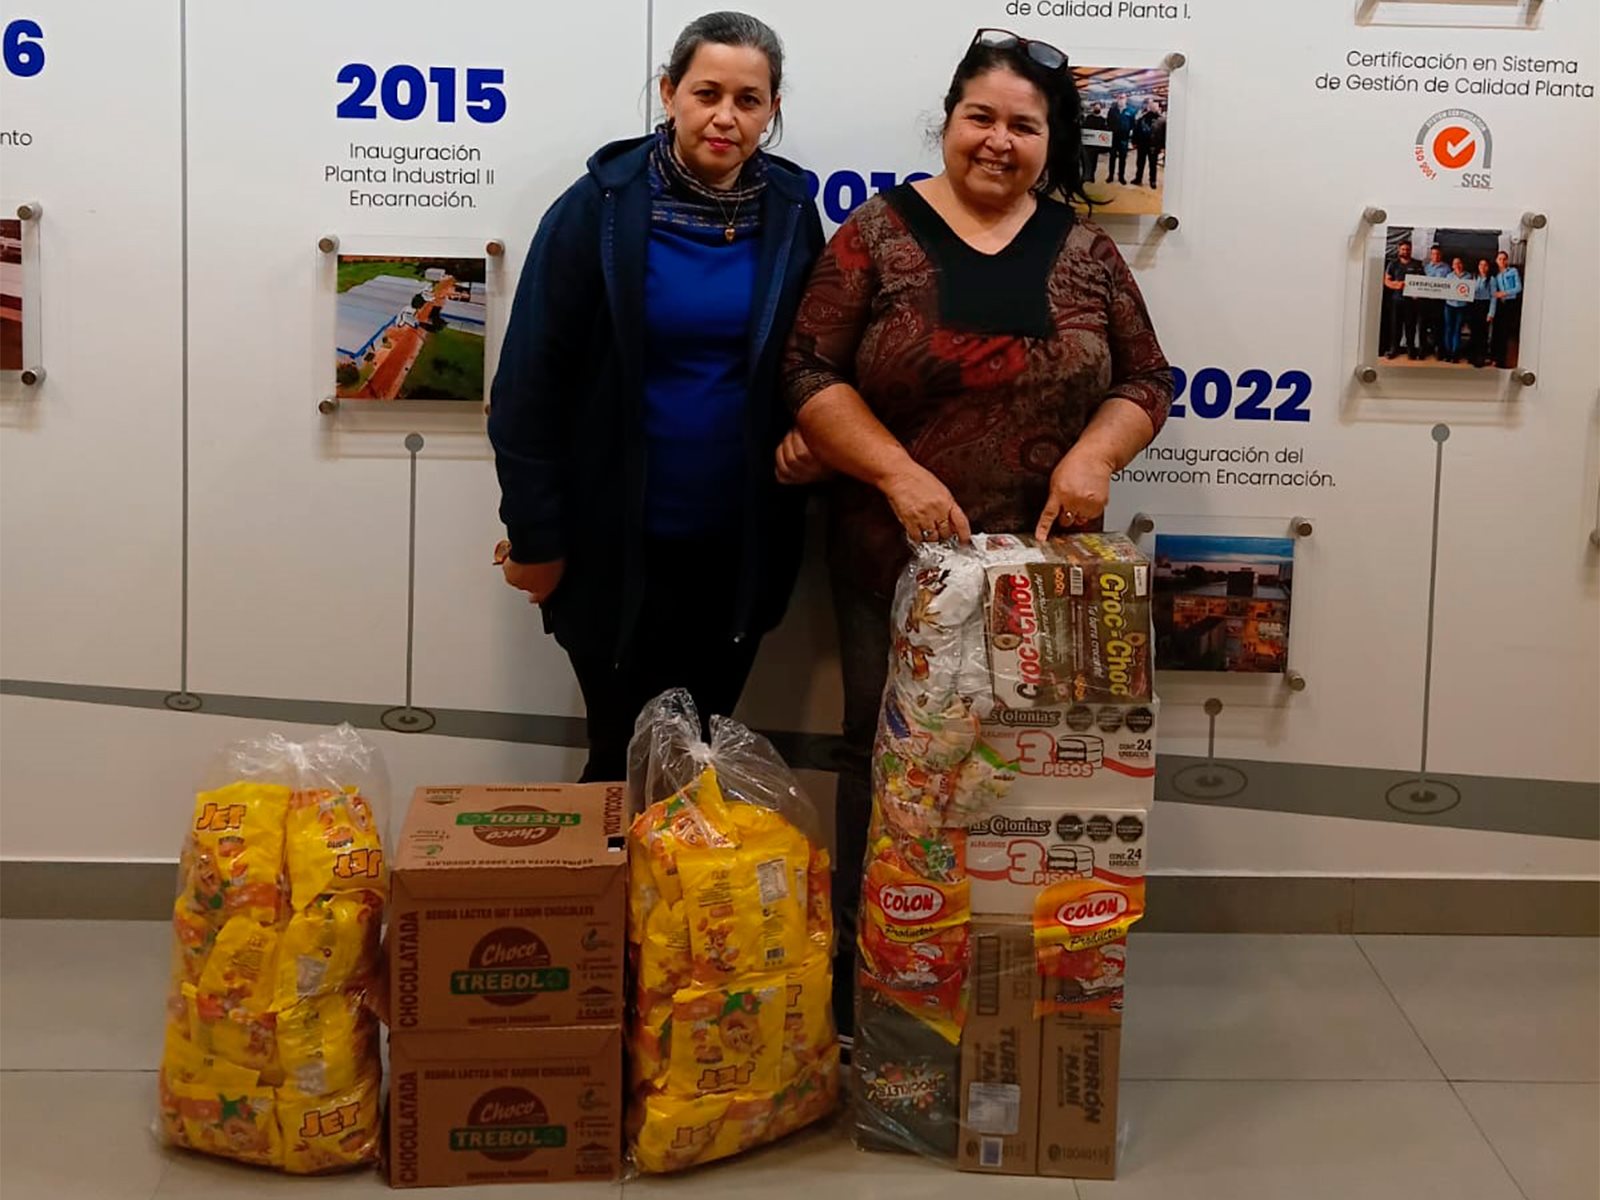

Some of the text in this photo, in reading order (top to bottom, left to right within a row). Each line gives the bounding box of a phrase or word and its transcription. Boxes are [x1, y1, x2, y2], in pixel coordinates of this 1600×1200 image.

[1006, 0, 1031, 15] de
[1037, 0, 1112, 17] Calidad
[1119, 2, 1177, 19] Planta
[1346, 51, 1578, 74] Certificación en Sistema
[336, 63, 508, 123] 2015
[1315, 73, 1594, 98] de Gestión de Calidad Planta
[349, 142, 481, 164] Inauguración
[325, 165, 495, 185] Planta Industrial II
[1461, 173, 1491, 188] SGS
[350, 190, 476, 209] Encarnación.
[1145, 446, 1303, 466] Inauguración del
[1111, 469, 1336, 487] Showroom Encarnación.
[1016, 730, 1056, 775] 3
[1137, 739, 1151, 751] 24
[1043, 762, 1094, 777] PISOS
[196, 803, 246, 831] JET
[485, 814, 576, 825] TREBOL
[990, 816, 1051, 836] Colonias
[486, 827, 548, 840] Choco
[333, 849, 382, 878] JET
[1007, 839, 1047, 884] 3
[1127, 849, 1142, 861] 24
[882, 893, 933, 912] COLON
[1063, 898, 1118, 921] COLON
[481, 943, 537, 966] Choco
[400, 911, 418, 1026] CHOCOLATADA
[456, 974, 544, 991] TREBOL
[300, 1102, 360, 1137] JET
[480, 1101, 536, 1123] Choco
[400, 1071, 418, 1183] CHOCOLATADA
[455, 1130, 542, 1147] TREBOL
